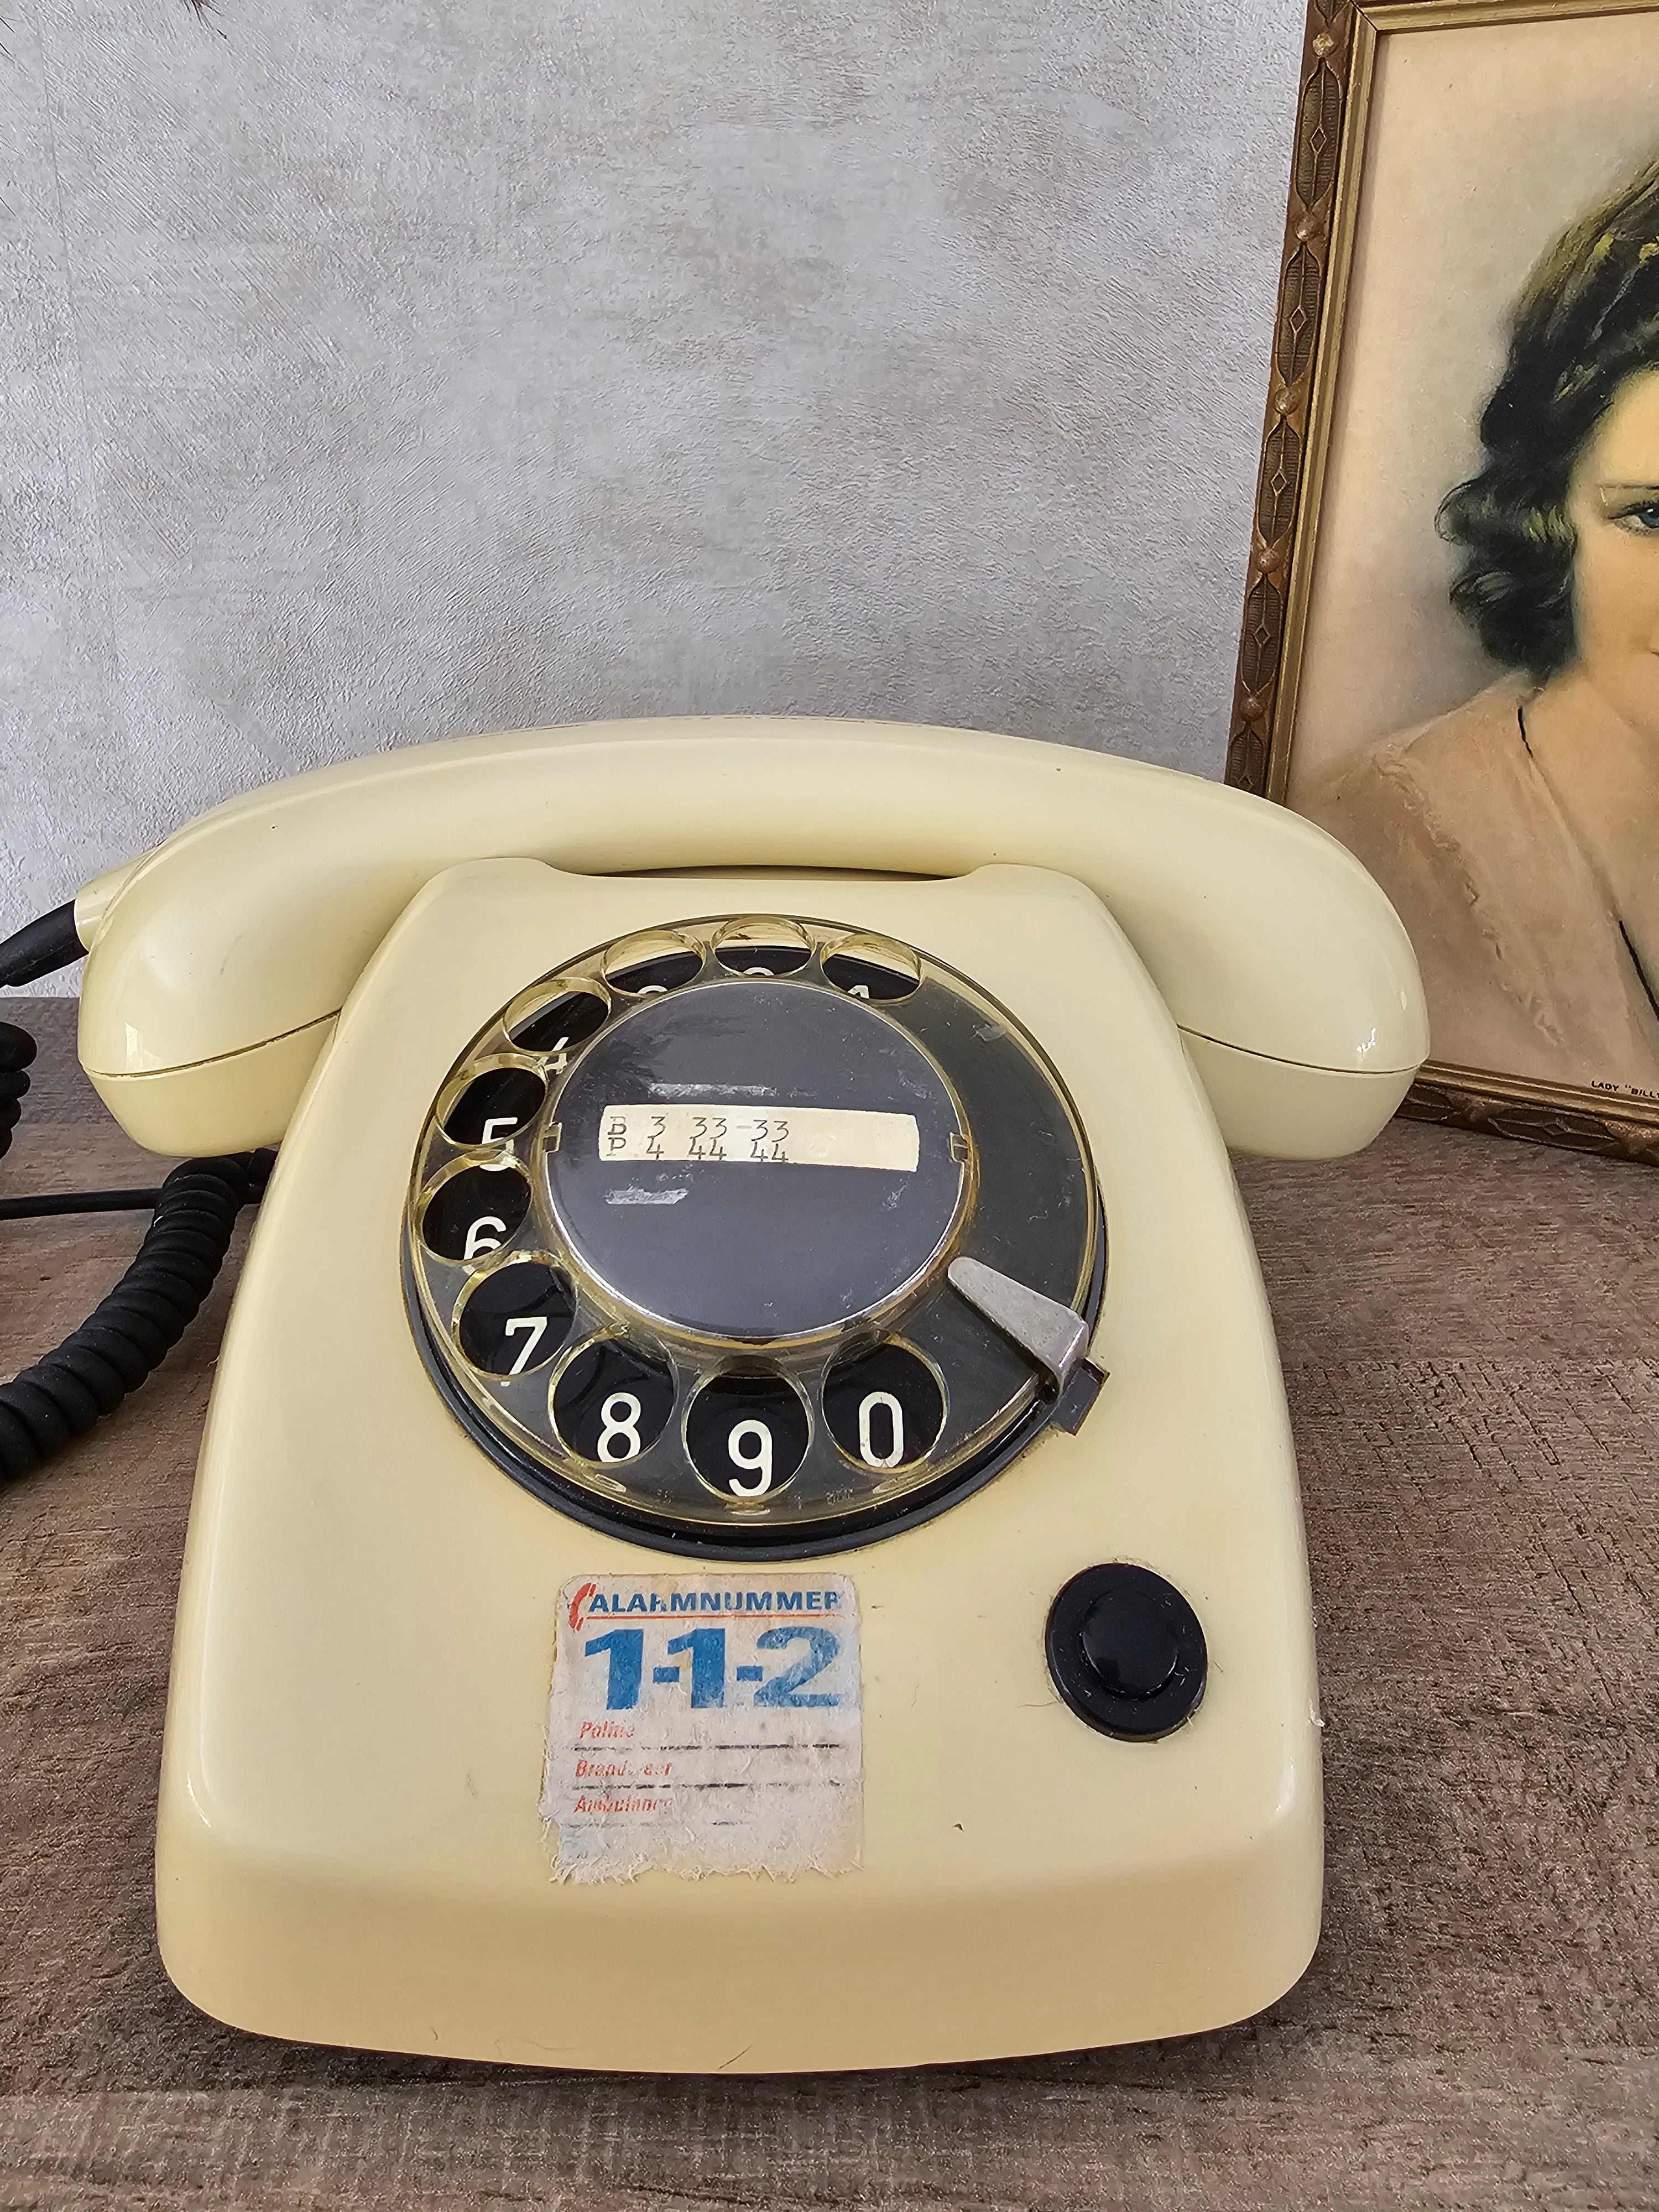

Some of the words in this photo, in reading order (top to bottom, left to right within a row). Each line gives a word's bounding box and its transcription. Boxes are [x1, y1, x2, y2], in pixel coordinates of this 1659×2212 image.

[1590, 1080, 1620, 1092] LADY
[606, 1136, 627, 1157] P
[646, 1136, 665, 1161] 4
[688, 1137, 727, 1161] 44
[750, 1142, 788, 1164] 44
[607, 1115, 627, 1136] B
[649, 1115, 666, 1139] 3
[463, 1216, 507, 1275] 6
[500, 1316, 547, 1387] 7
[597, 1392, 641, 1463] 8
[728, 1420, 773, 1497] 9
[859, 1391, 904, 1468] 0
[588, 1590, 841, 1613] ALARMNUMMER
[585, 1626, 844, 1710] 1-1-2
